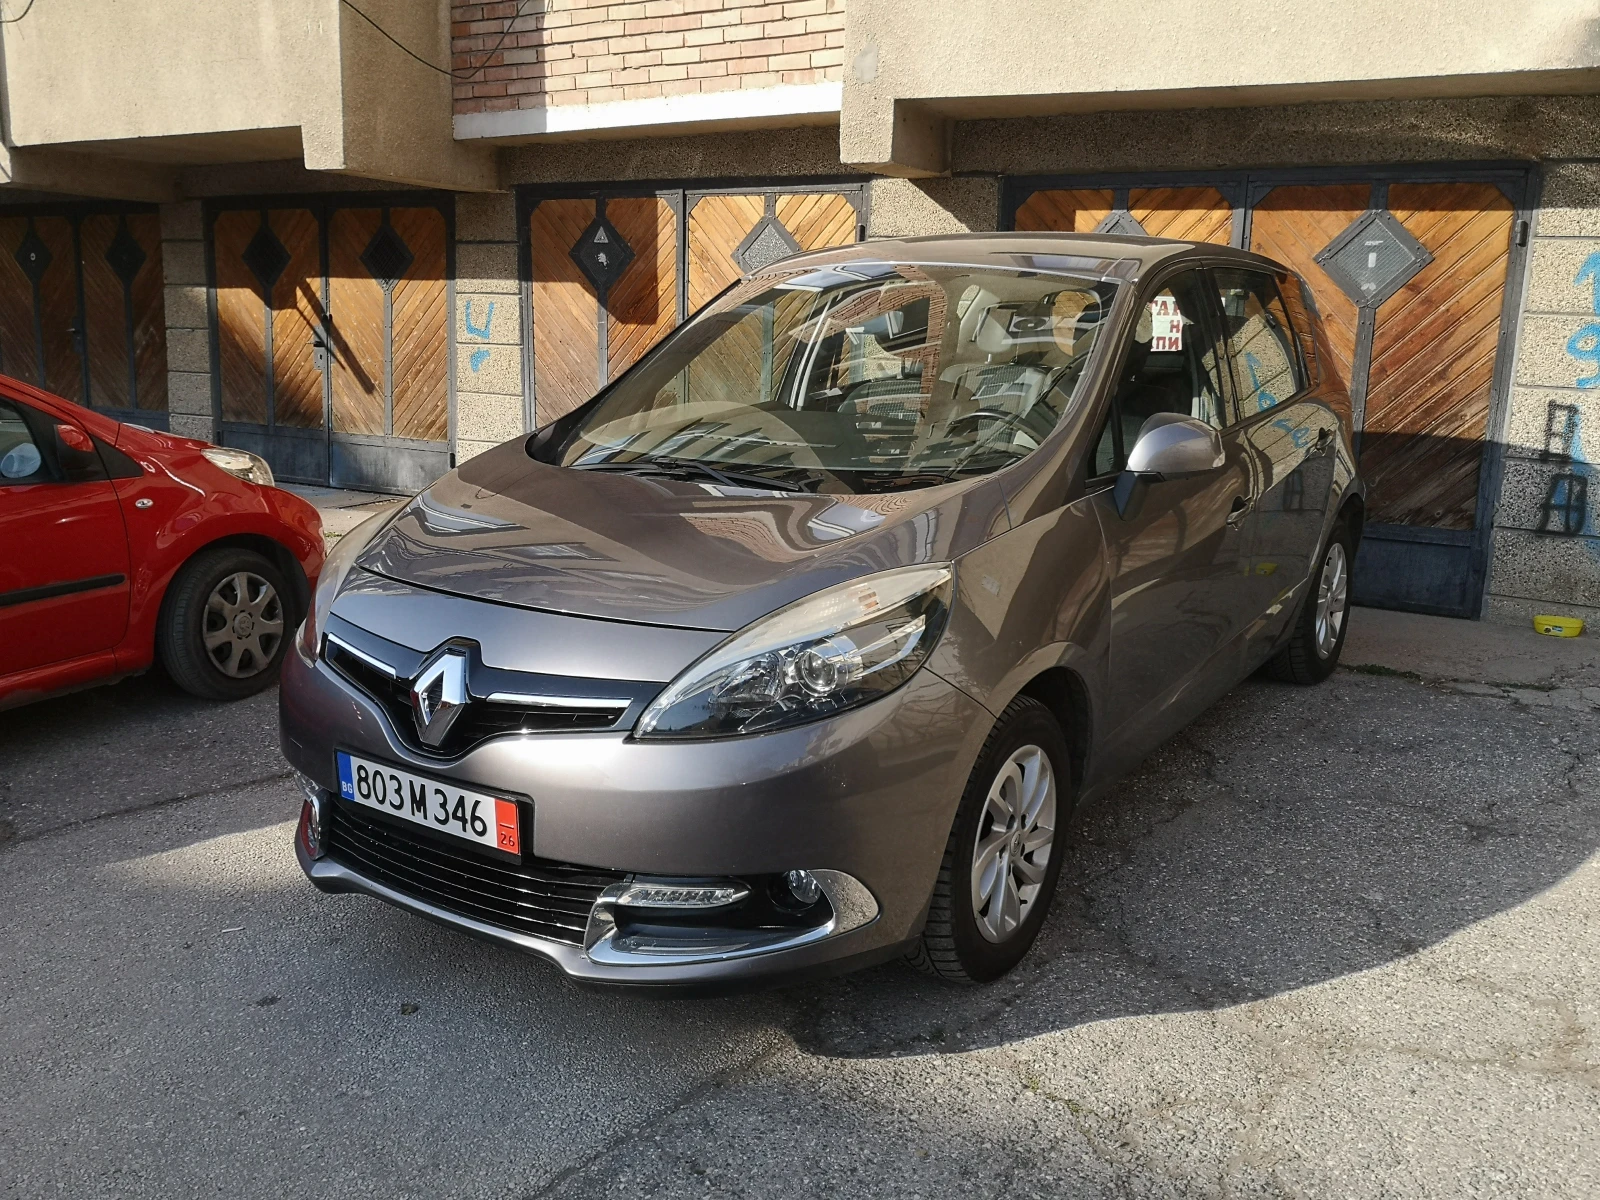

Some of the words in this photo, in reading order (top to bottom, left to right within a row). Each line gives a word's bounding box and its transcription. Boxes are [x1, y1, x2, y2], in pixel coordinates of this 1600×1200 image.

[342, 781, 353, 794] BG
[356, 764, 405, 811] 803
[408, 779, 429, 821] M
[433, 788, 488, 837] 346
[500, 833, 516, 847] 26
